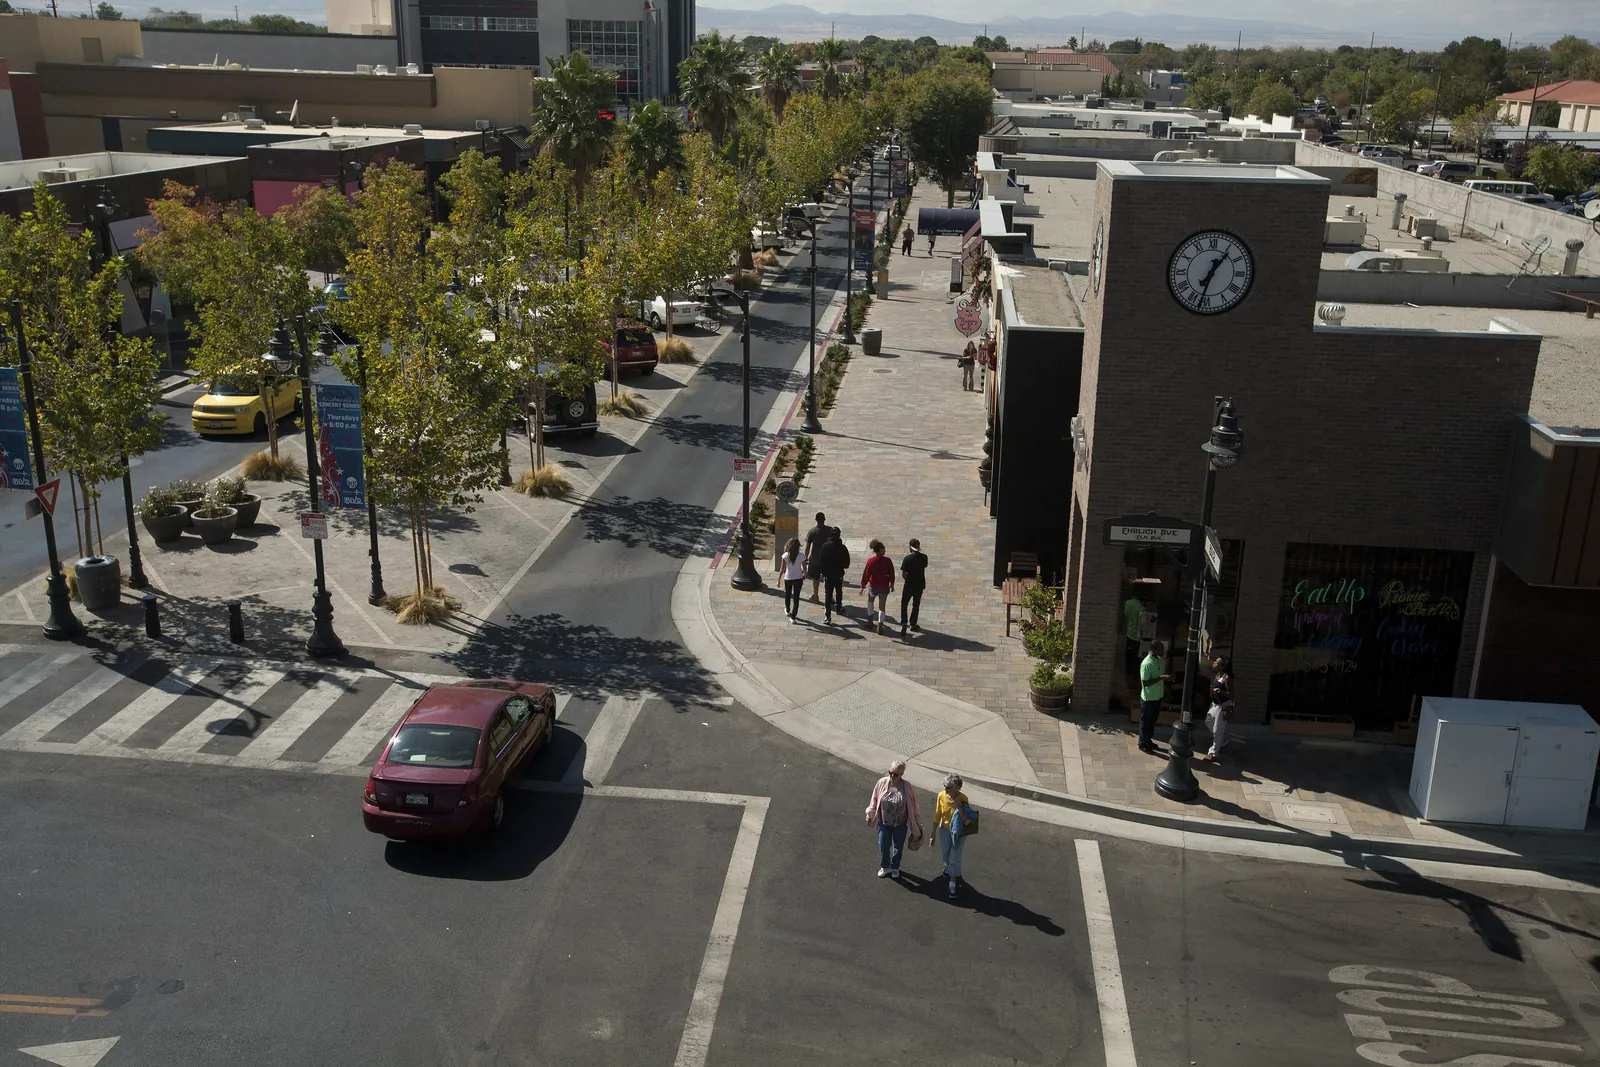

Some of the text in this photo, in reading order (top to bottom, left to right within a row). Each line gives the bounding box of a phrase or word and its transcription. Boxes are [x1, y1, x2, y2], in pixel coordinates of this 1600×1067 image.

[1193, 242, 1203, 253] XI
[1208, 239, 1218, 249] XII
[1181, 253, 1192, 262] X
[327, 413, 360, 422] Thursdays
[1291, 576, 1365, 615] Eat Up
[394, 819, 432, 827] SATURN
